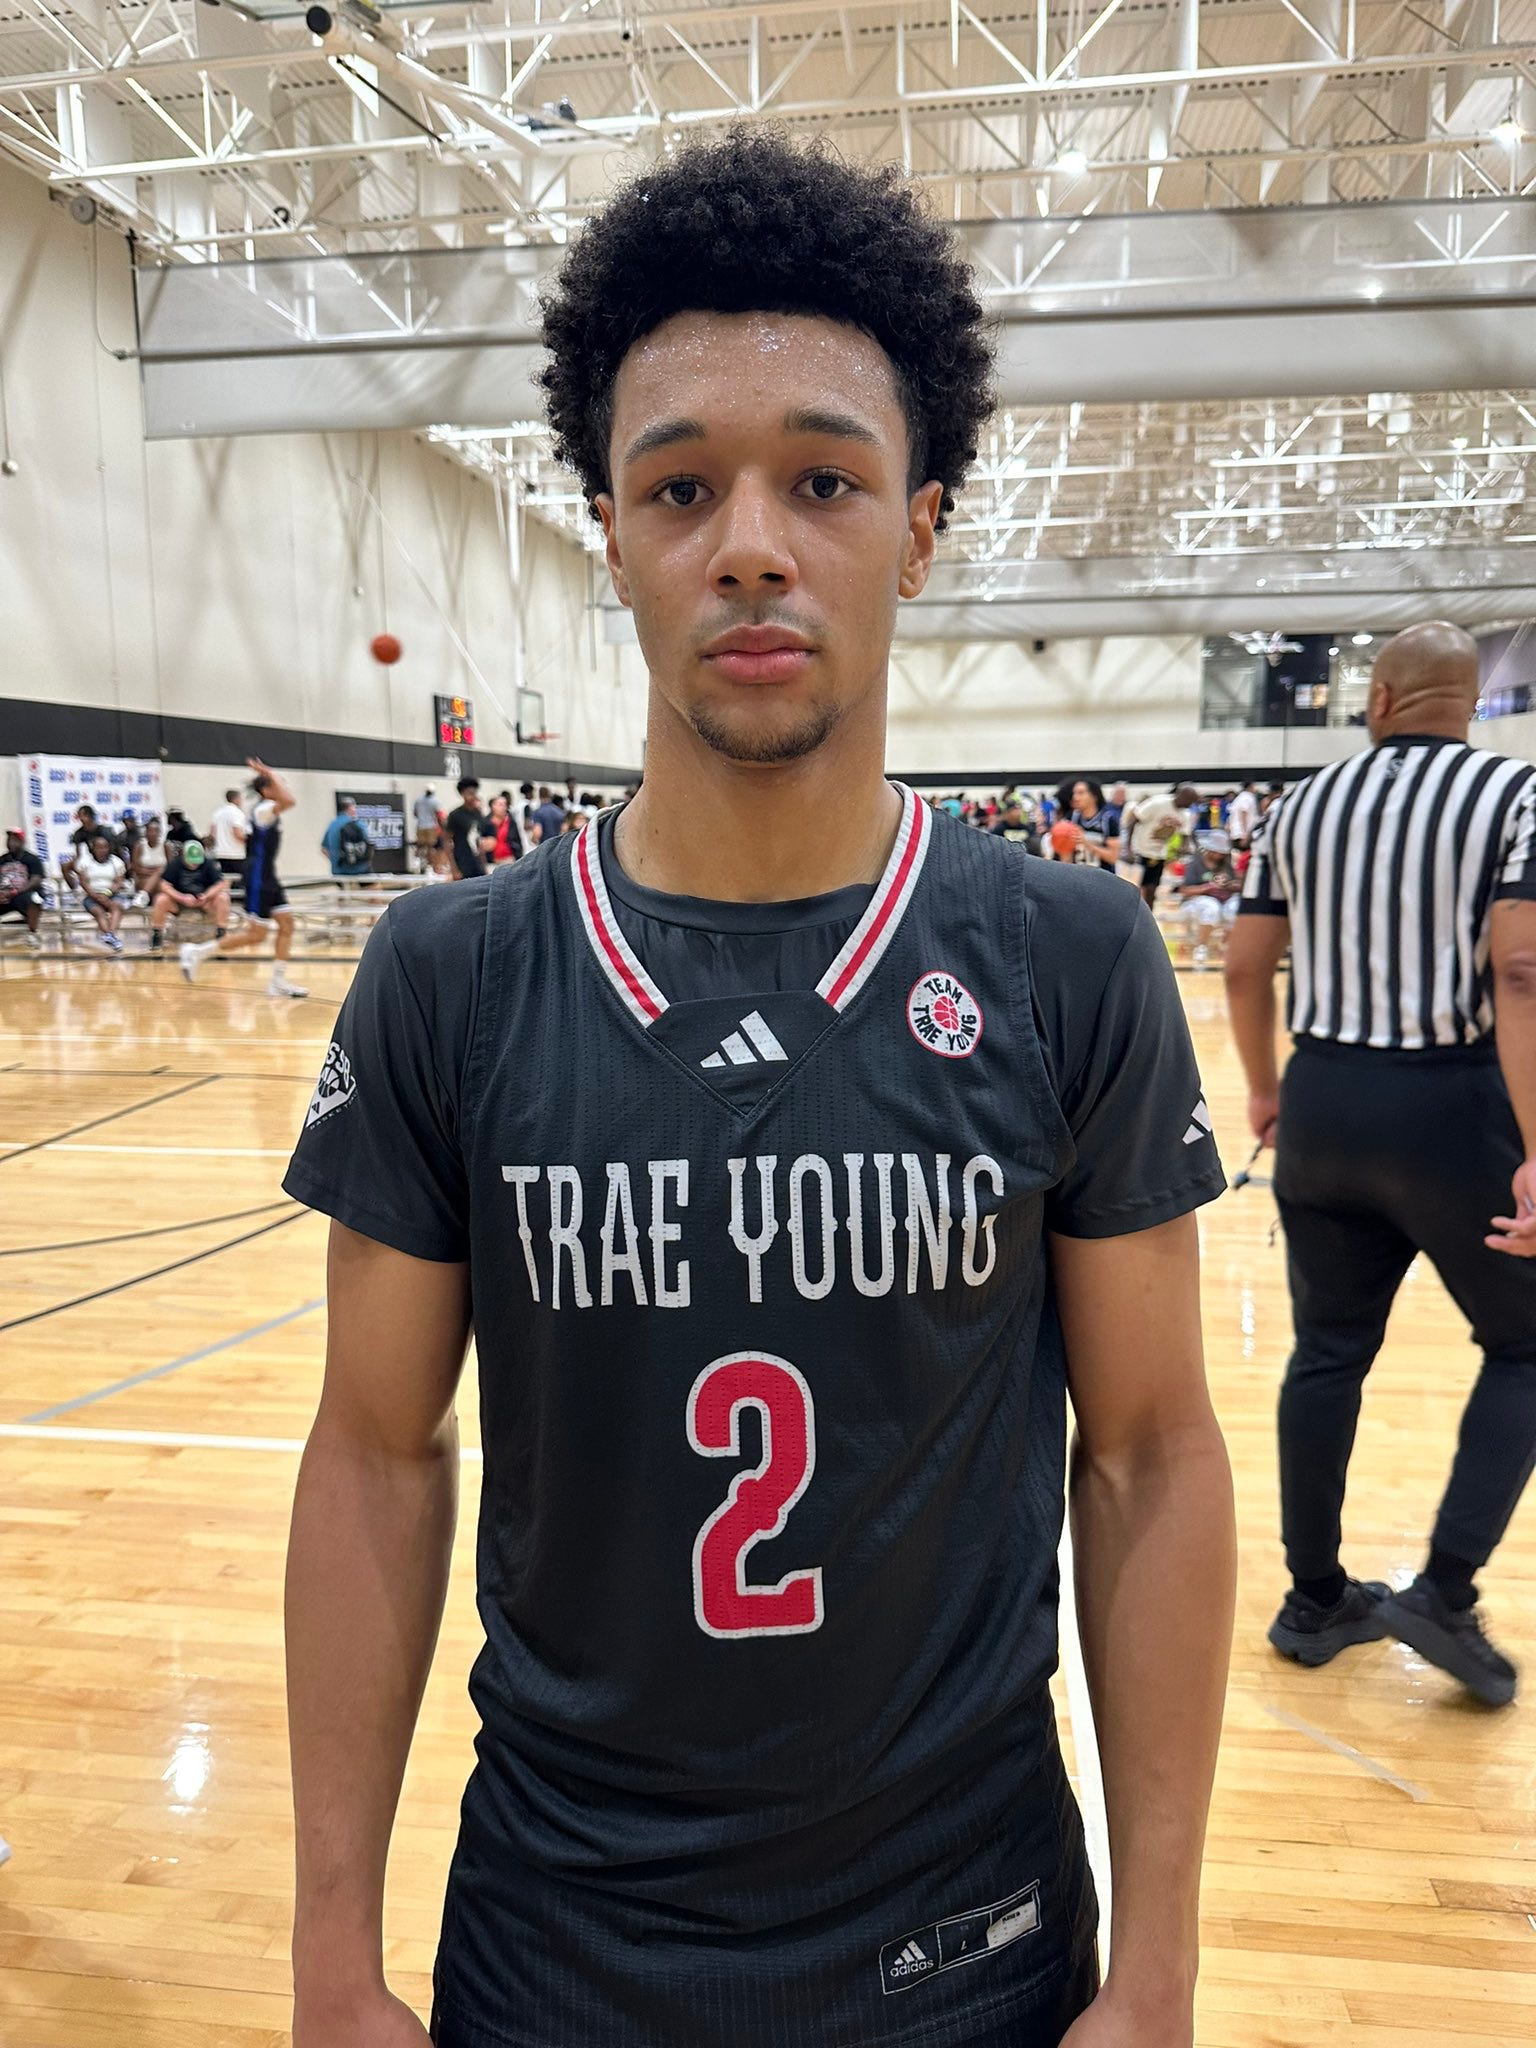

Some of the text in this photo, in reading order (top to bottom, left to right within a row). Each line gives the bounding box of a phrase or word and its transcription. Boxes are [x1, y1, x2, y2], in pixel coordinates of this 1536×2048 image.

[923, 977, 963, 1004] TEAM
[913, 1004, 942, 1044] TRAE
[501, 1152, 1005, 1310] TRAE YOUNG
[686, 1350, 825, 1639] 2
[890, 1959, 934, 1977] adidas
